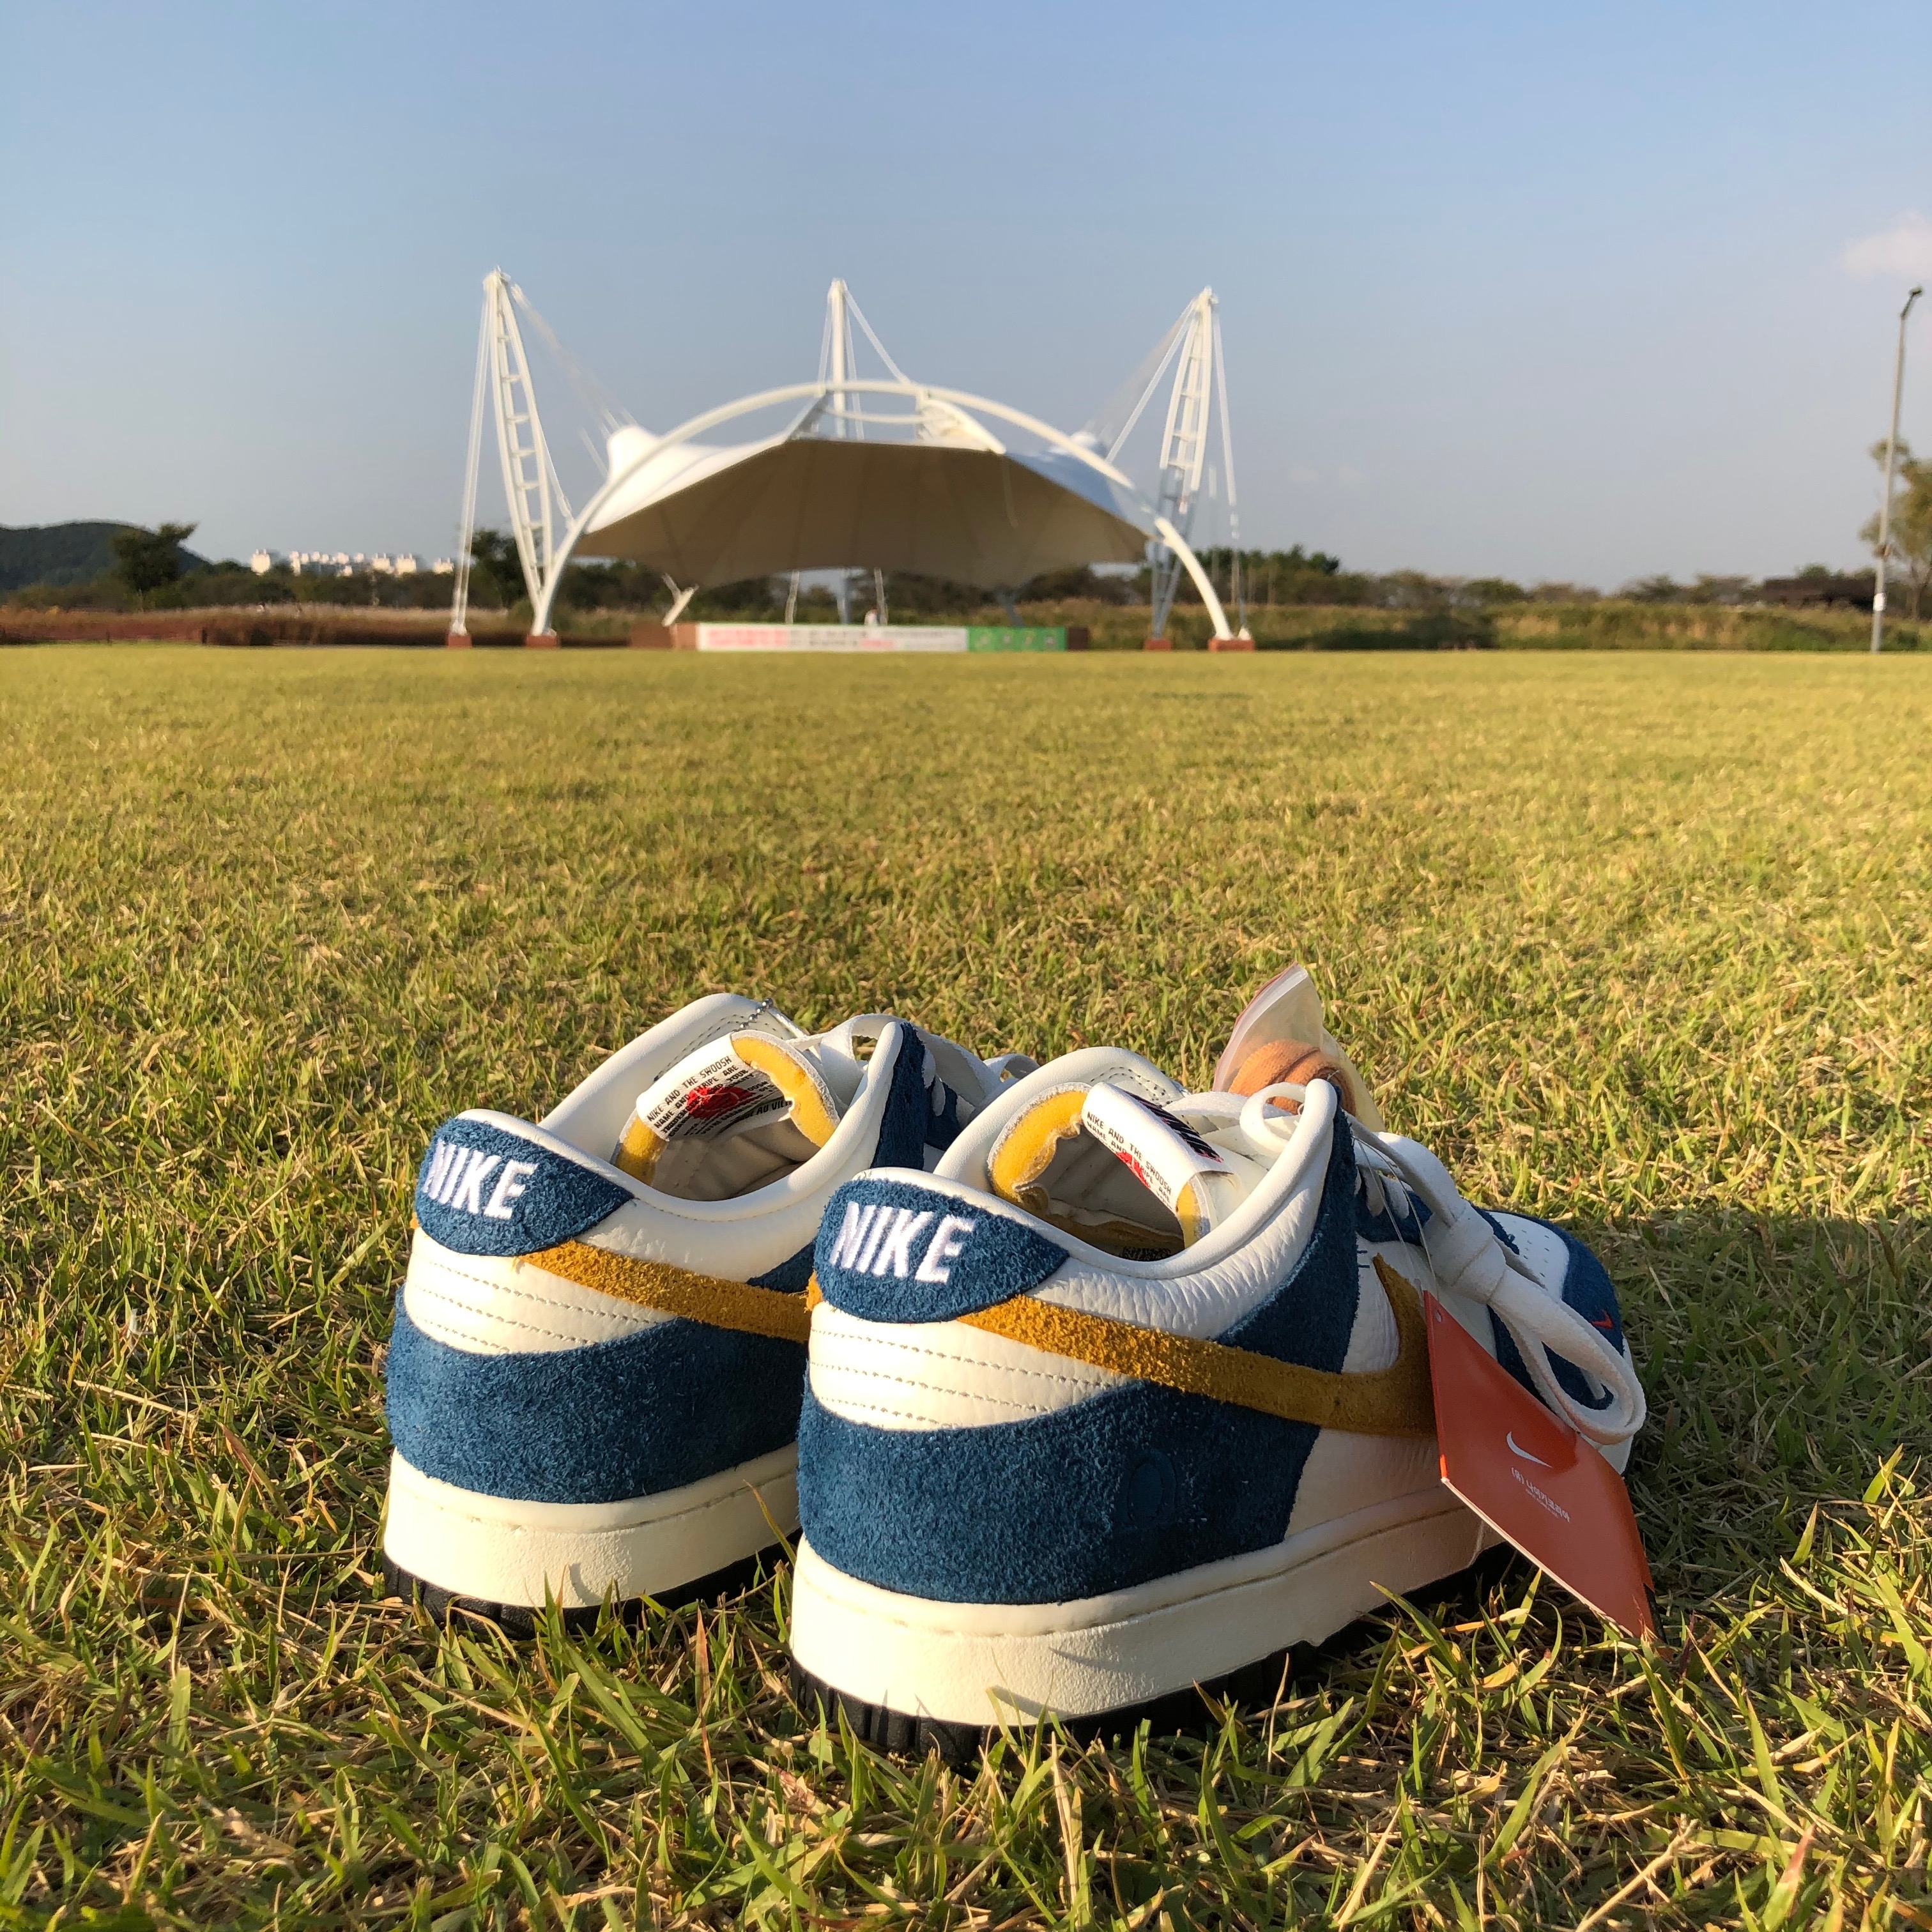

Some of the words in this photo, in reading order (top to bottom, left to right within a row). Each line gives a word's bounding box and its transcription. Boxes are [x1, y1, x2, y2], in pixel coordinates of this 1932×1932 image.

[647, 1105, 664, 1122] NIKE
[664, 1089, 680, 1105] AND
[682, 1077, 698, 1089] THE
[699, 1055, 732, 1078] SWOOSH
[654, 1110, 674, 1129] NAME
[675, 1094, 690, 1109] AND
[723, 1064, 739, 1077] ARE
[726, 1070, 749, 1082] YOUR
[421, 1138, 539, 1220] NIKE
[1087, 1112, 1104, 1129] NIKE
[1108, 1128, 1124, 1144] AND
[1130, 1143, 1143, 1161] THE
[1146, 1161, 1172, 1195] SWOOSH
[1087, 1121, 1107, 1141] NAME
[1111, 1140, 1127, 1154] AND
[1158, 1186, 1170, 1203] ARE
[831, 1200, 976, 1284] NIKE
